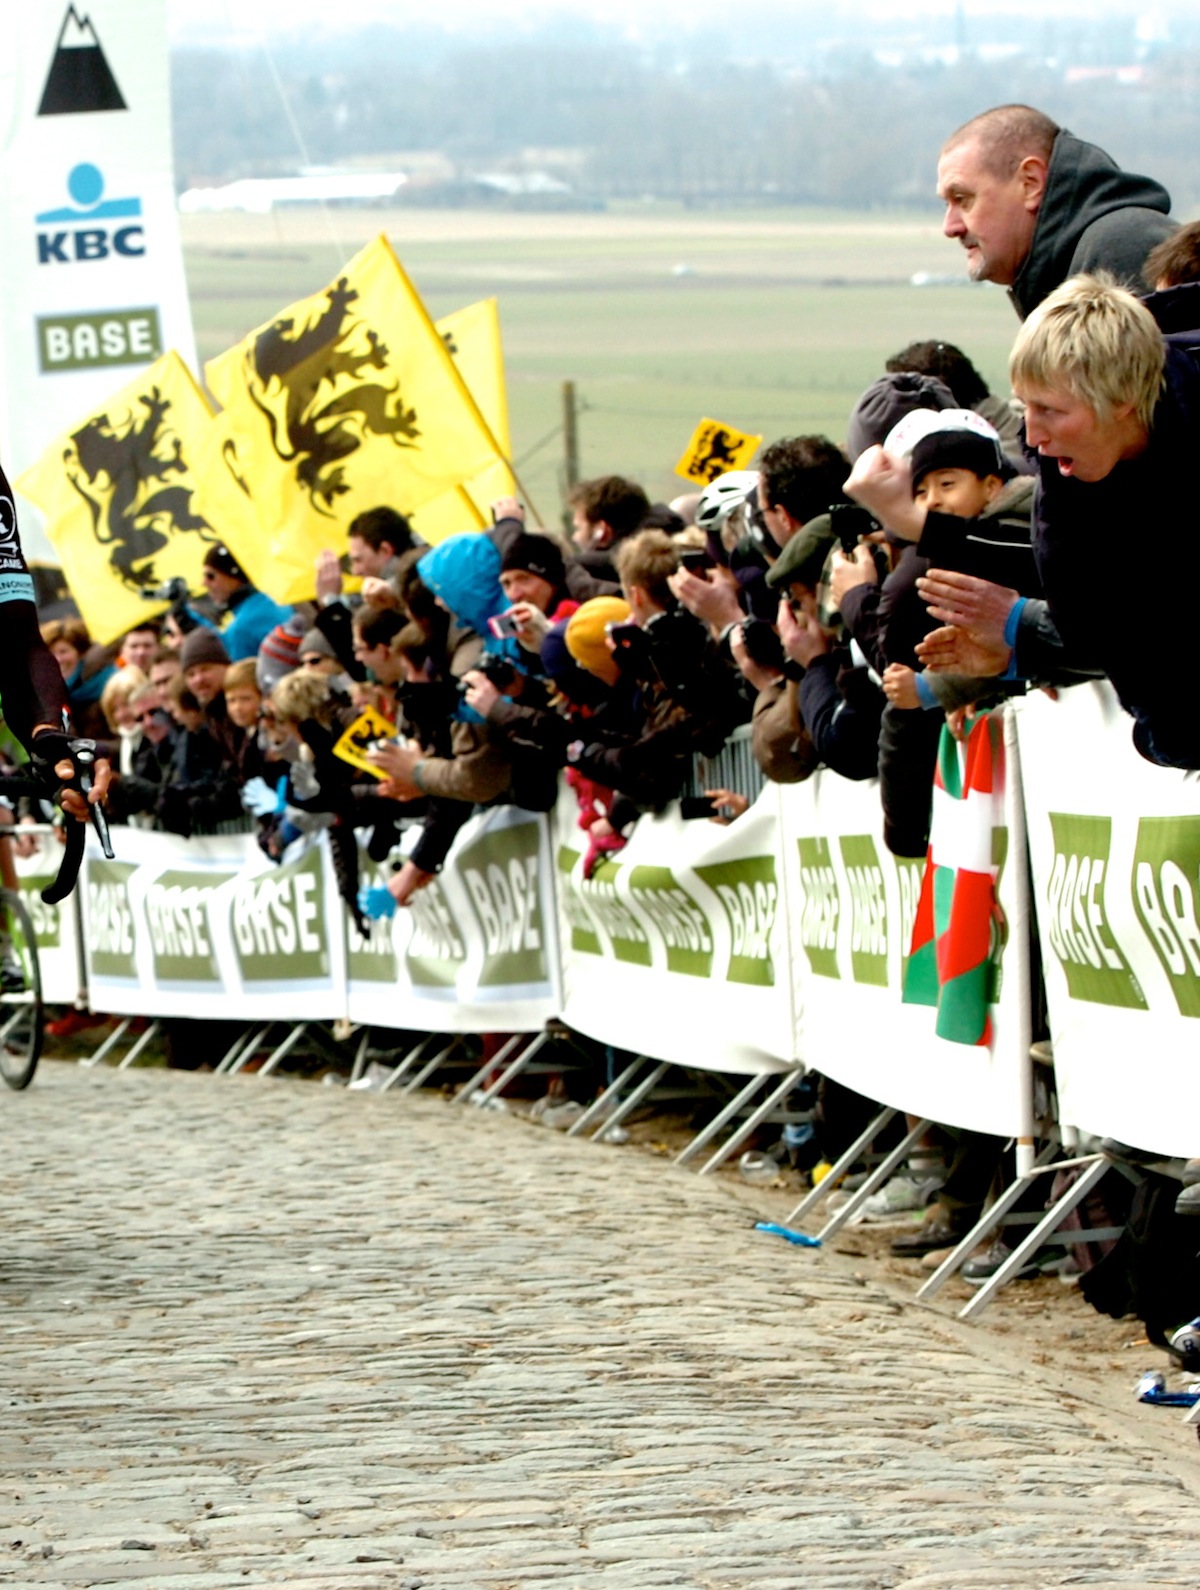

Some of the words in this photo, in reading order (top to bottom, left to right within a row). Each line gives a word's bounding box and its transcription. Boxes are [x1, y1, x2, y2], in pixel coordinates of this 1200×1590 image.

[36, 226, 145, 265] KBC
[45, 319, 152, 362] BASE
[89, 882, 133, 954] BASE
[149, 884, 210, 957] BASE
[233, 873, 321, 956] BASE
[464, 855, 541, 956] BASE
[716, 880, 778, 960] BASE
[845, 865, 889, 956] BASE
[1047, 853, 1124, 970] BASE
